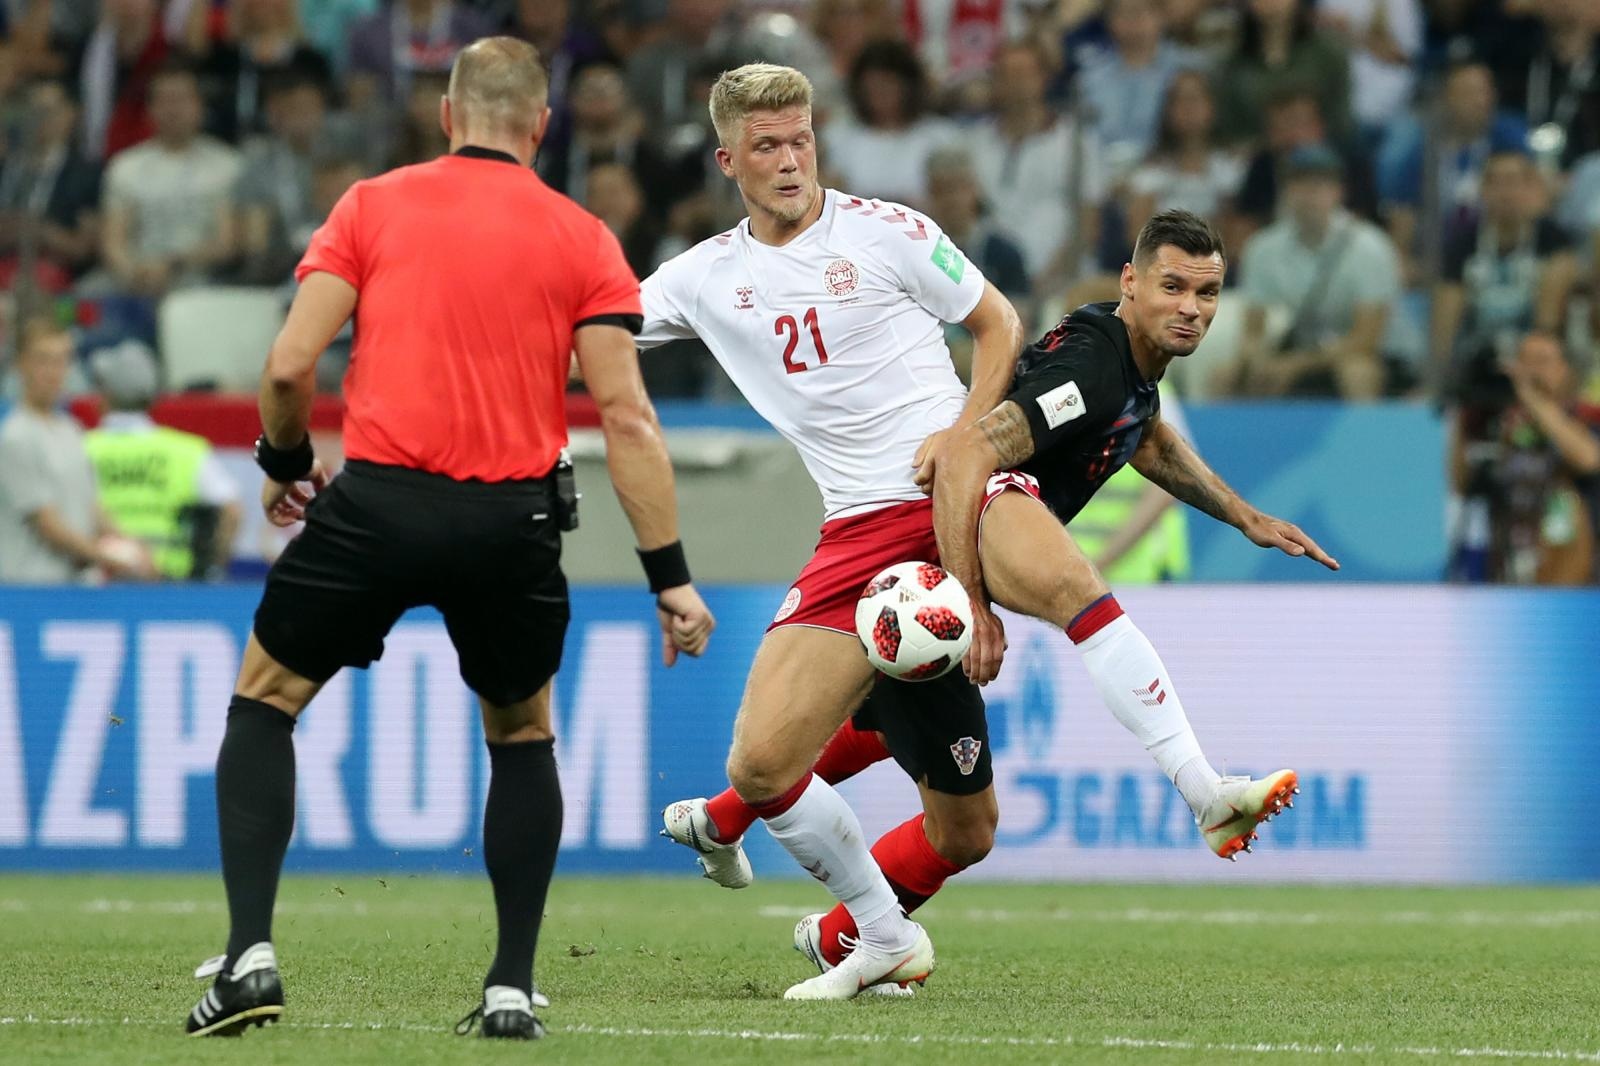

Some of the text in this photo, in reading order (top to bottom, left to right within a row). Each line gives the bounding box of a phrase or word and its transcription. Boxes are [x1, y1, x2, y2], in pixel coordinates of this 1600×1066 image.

[774, 307, 829, 374] 21
[0, 621, 650, 849] ZPOM
[1072, 771, 1367, 849] GAZOM
